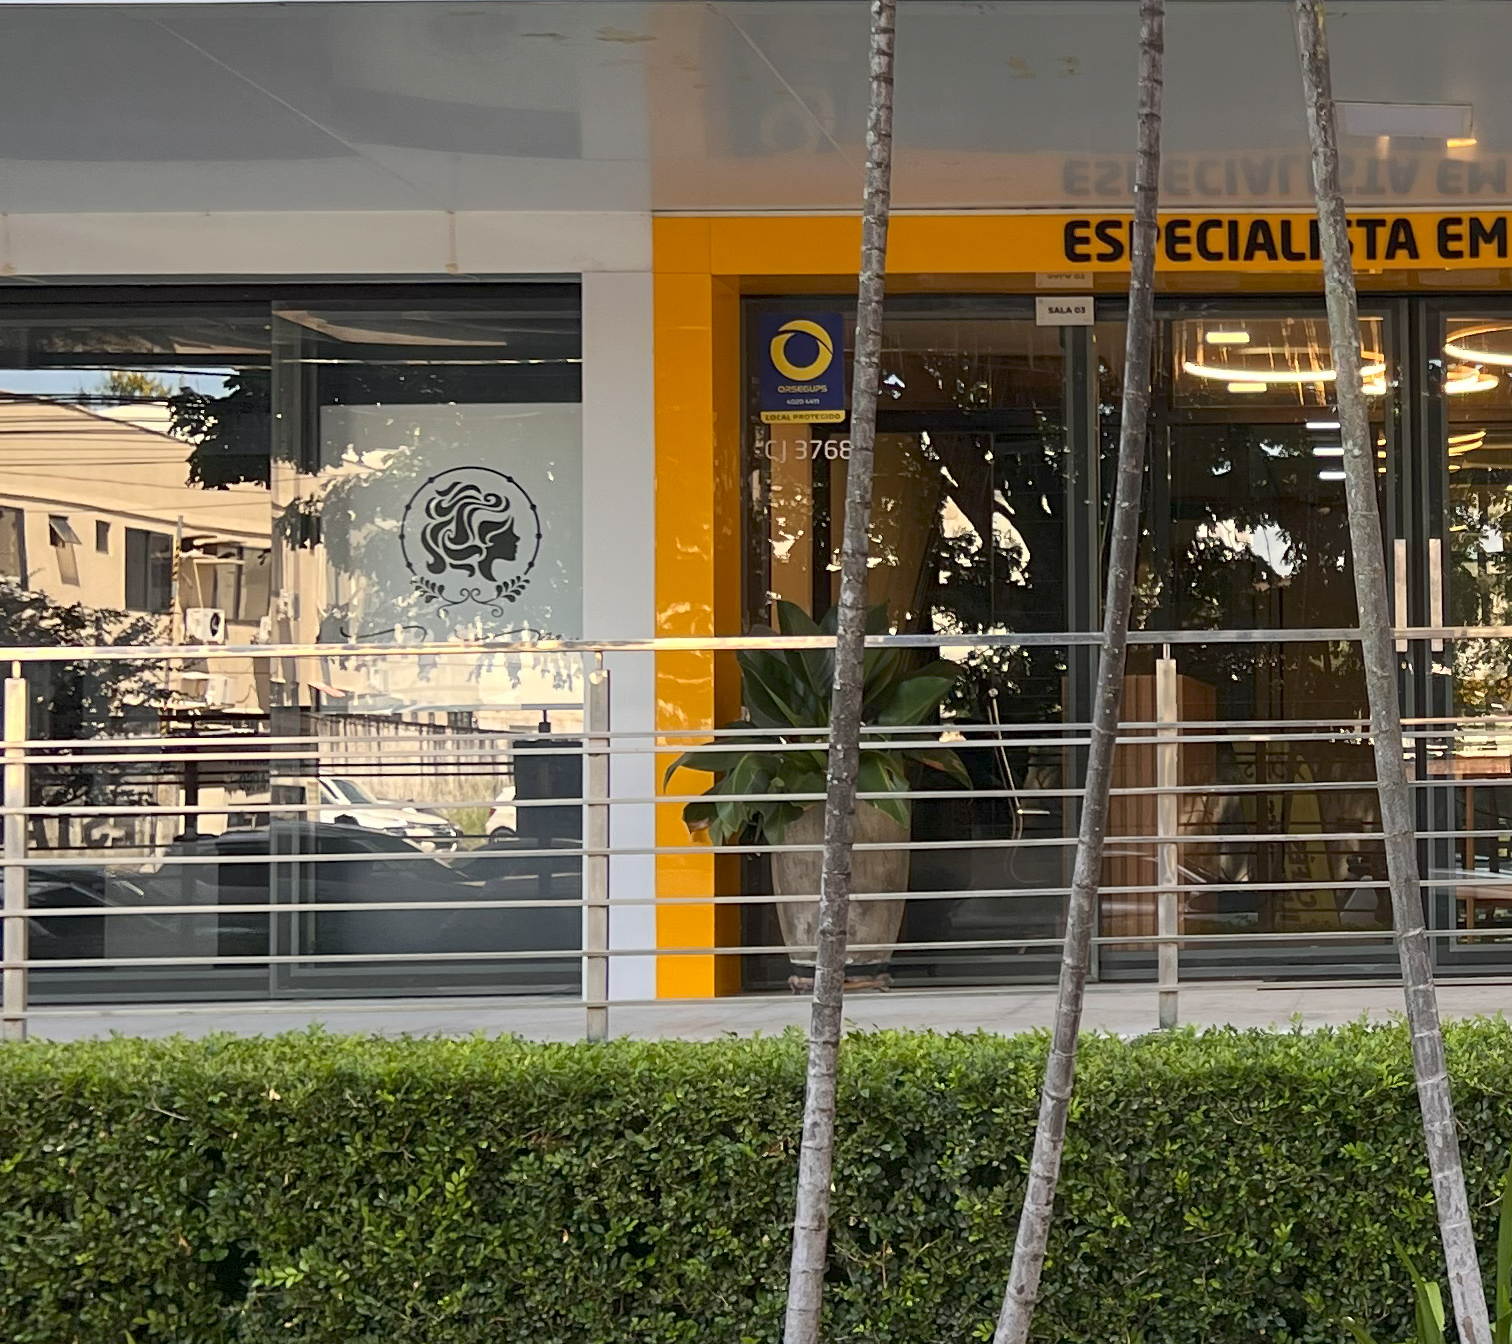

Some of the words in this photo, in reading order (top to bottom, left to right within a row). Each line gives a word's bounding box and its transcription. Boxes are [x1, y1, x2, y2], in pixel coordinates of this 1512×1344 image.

[1064, 219, 1420, 263] ESECIALITA
[1437, 216, 1508, 259] EM
[1048, 306, 1072, 314] SALA
[1074, 306, 1086, 314] 03
[777, 385, 828, 393] ORSEGUPS
[765, 440, 787, 463] CJ
